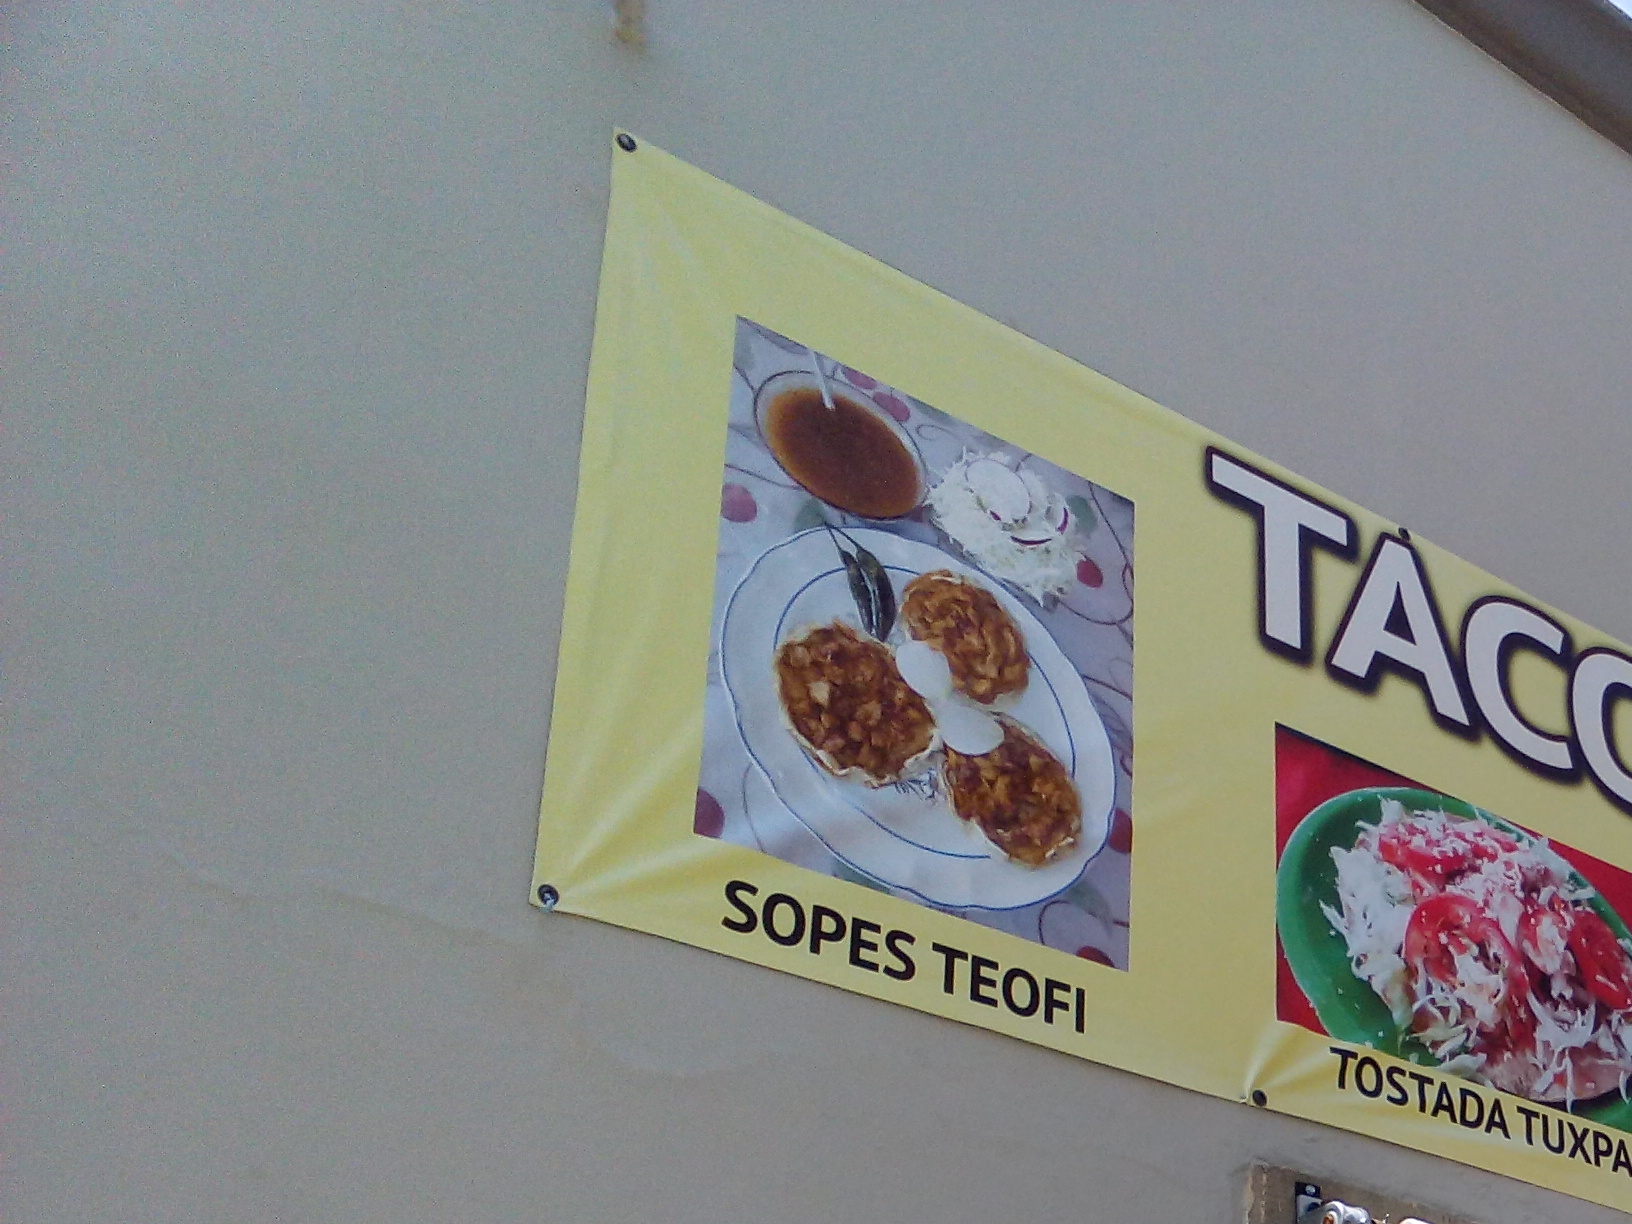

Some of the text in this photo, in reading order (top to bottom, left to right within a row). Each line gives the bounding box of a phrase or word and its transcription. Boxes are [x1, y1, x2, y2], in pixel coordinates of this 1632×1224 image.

[721, 879, 1087, 1034] SOPES TEOFI
[1329, 1046, 1511, 1140] TOSTADA
